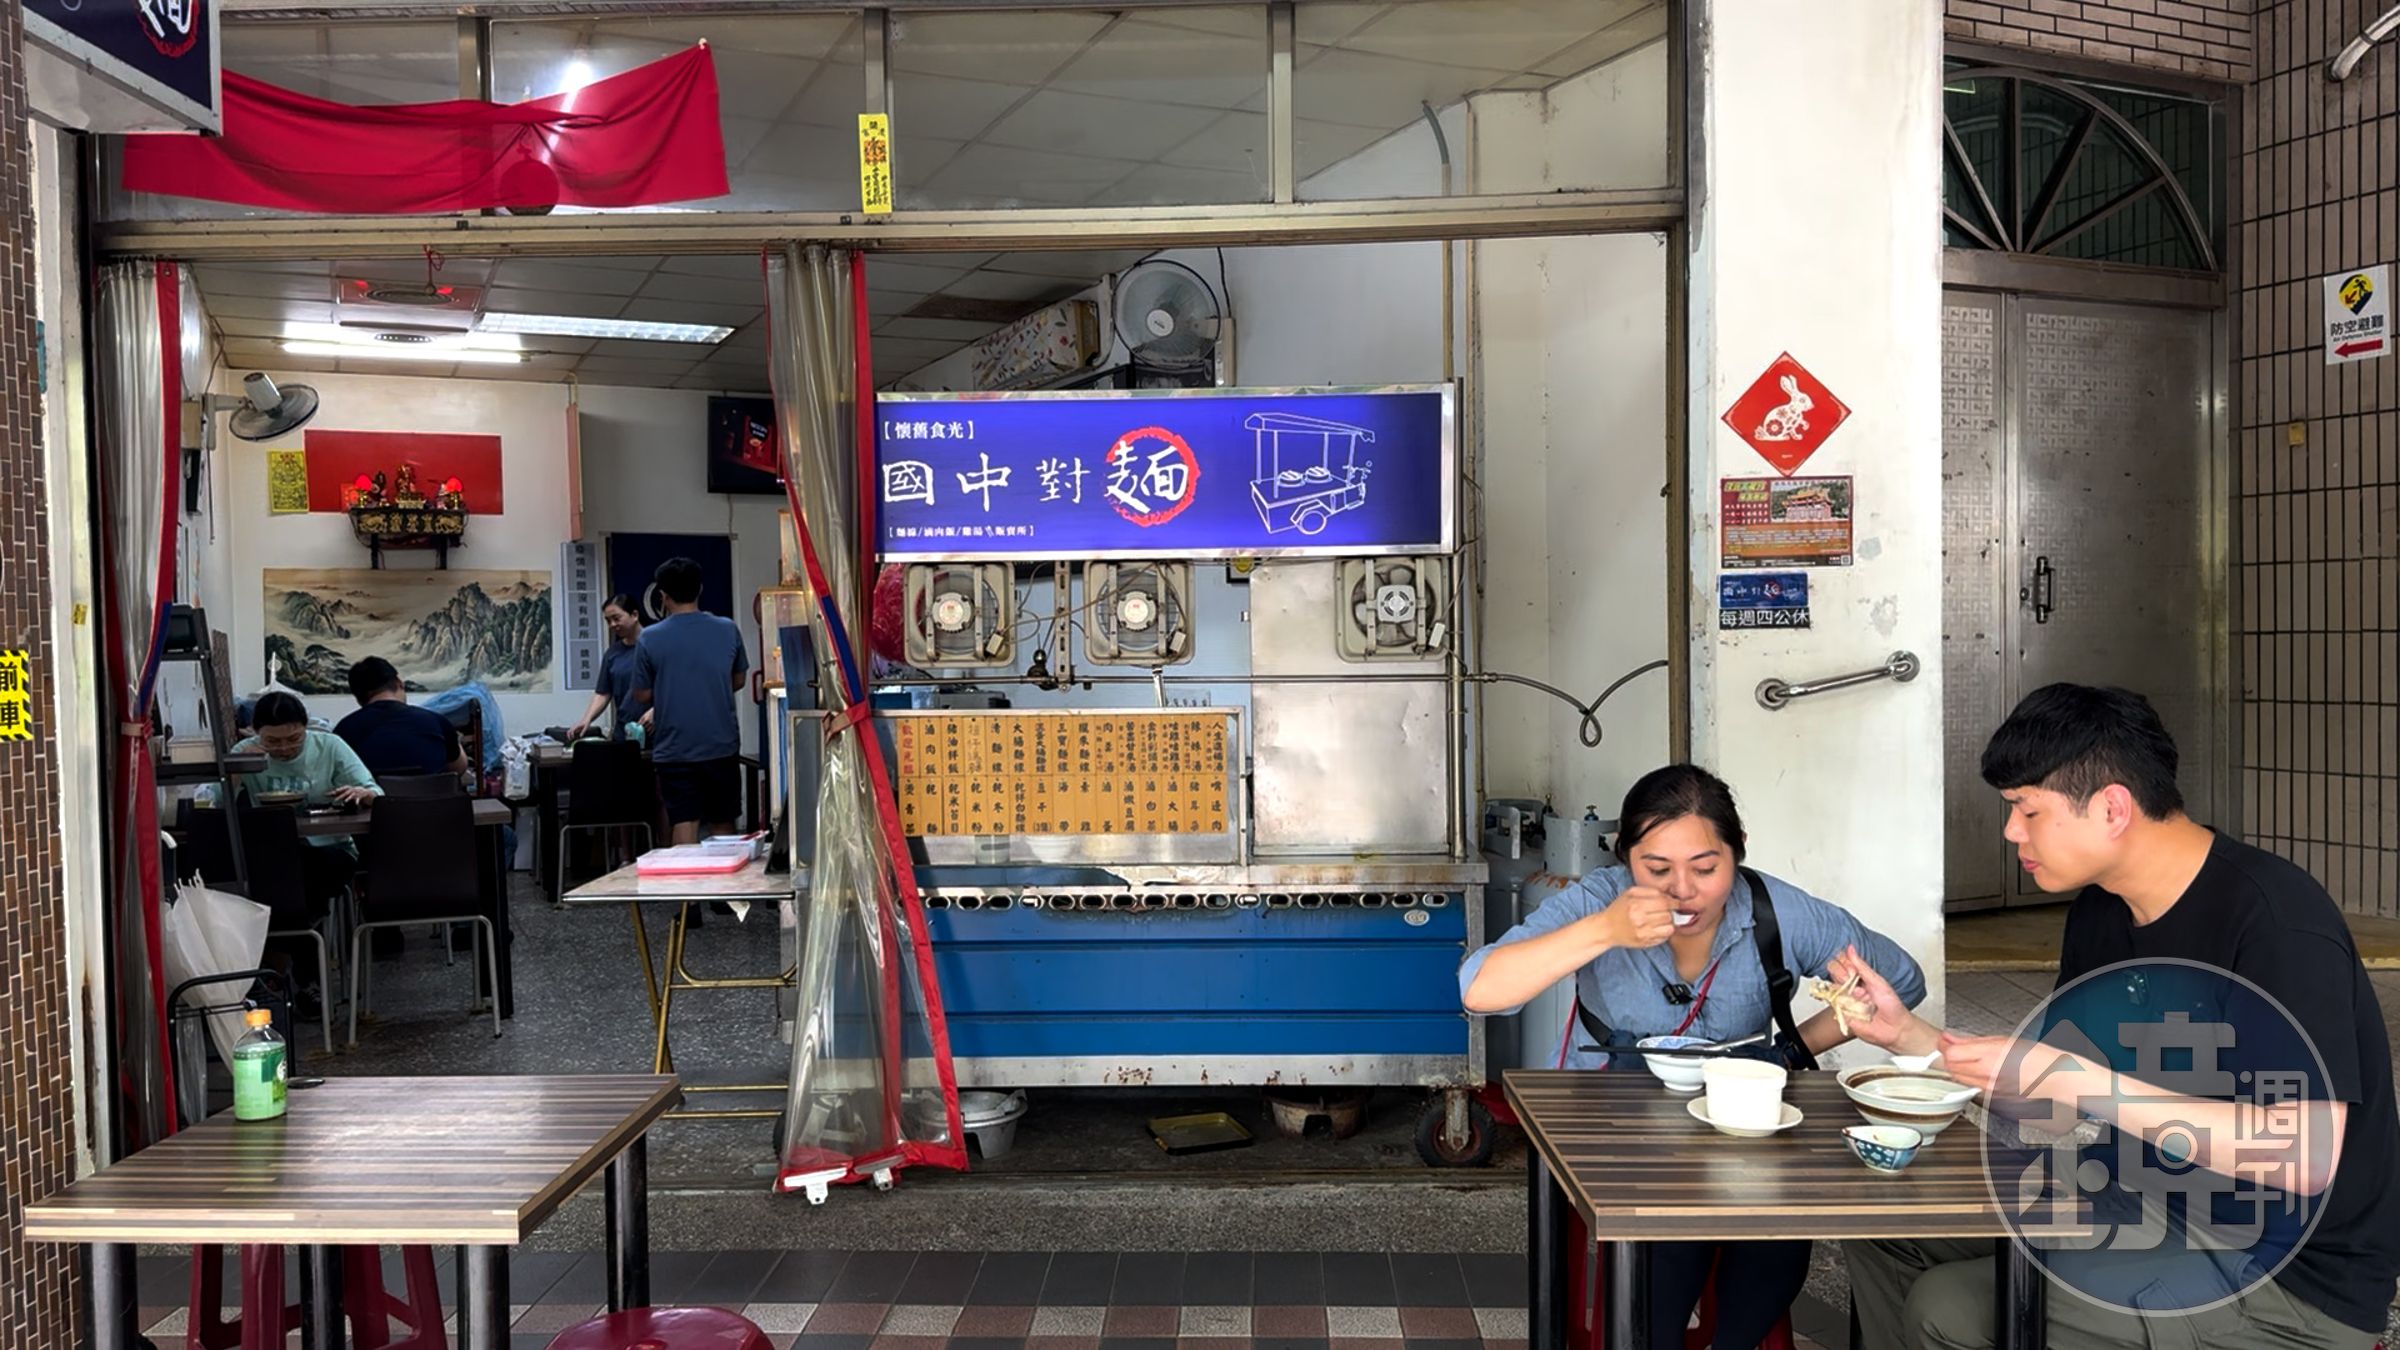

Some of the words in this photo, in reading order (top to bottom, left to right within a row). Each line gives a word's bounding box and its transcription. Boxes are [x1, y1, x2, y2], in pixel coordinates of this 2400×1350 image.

[2331, 315, 2384, 337] 防空避難
[1720, 609, 1808, 627] 每週四公休
[925, 724, 936, 774] 滷肉飯
[904, 783, 915, 834] 燙青菜
[971, 782, 982, 833] 乾米粉
[992, 782, 1004, 833] 乾冬粉
